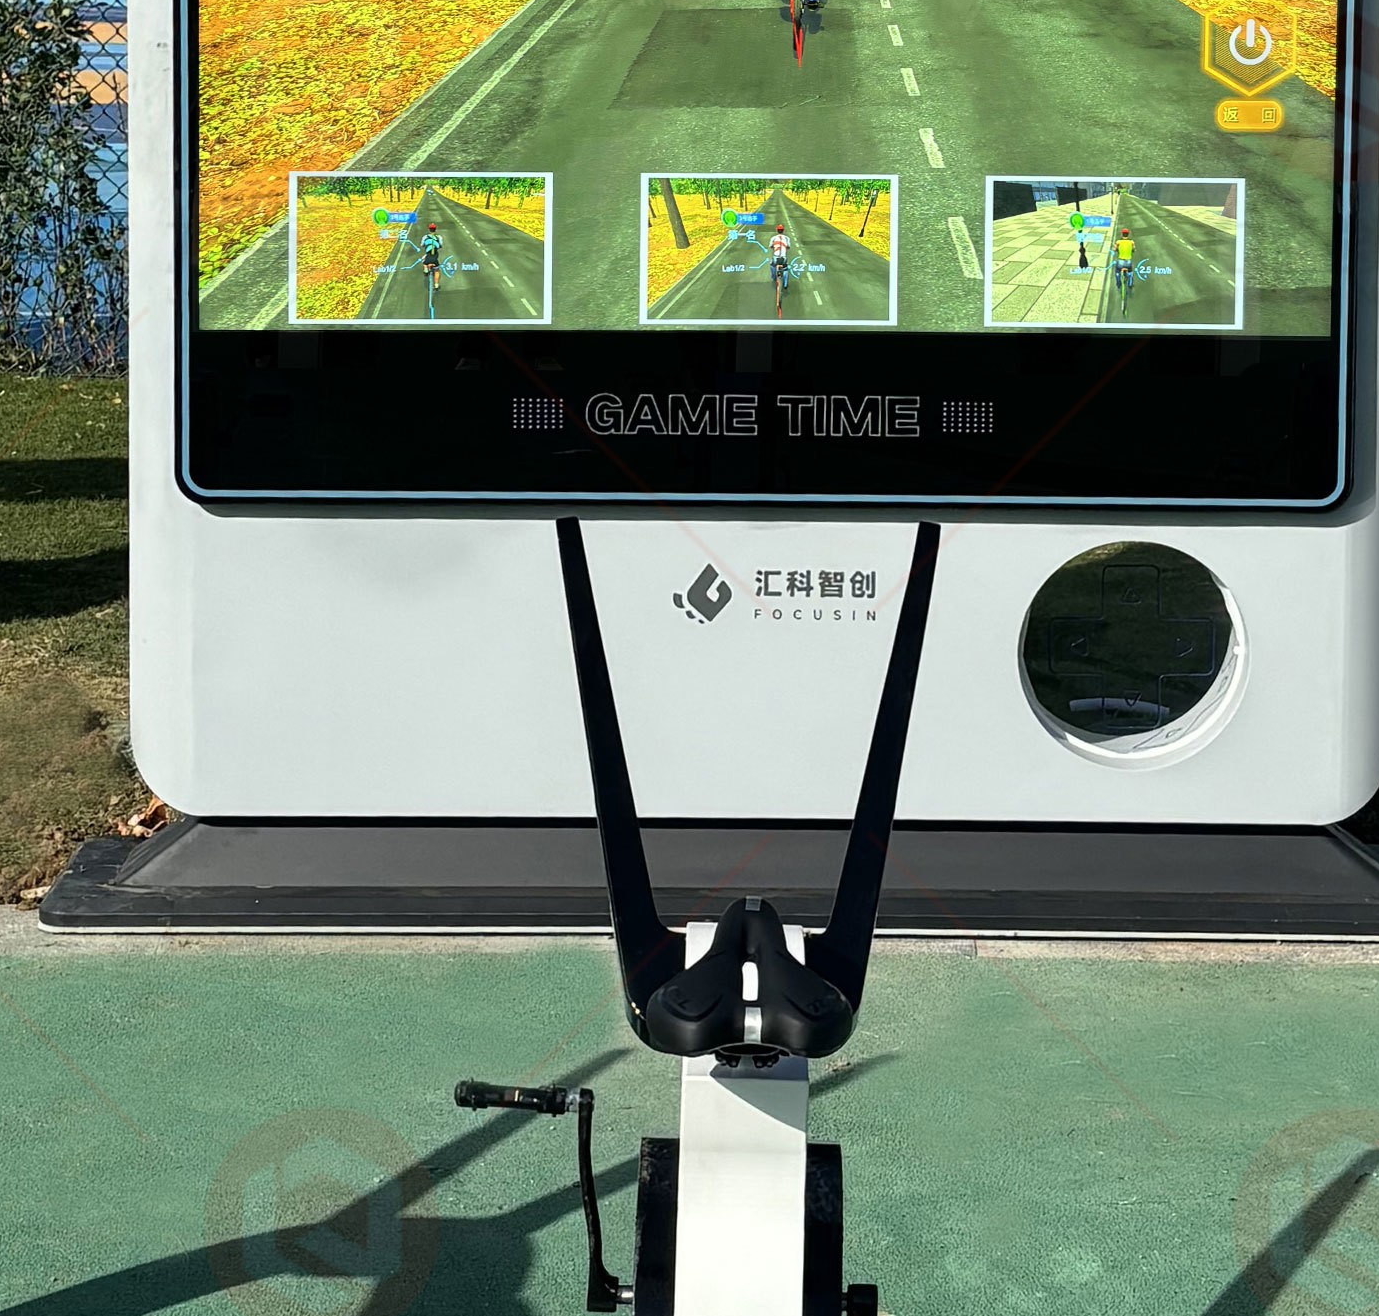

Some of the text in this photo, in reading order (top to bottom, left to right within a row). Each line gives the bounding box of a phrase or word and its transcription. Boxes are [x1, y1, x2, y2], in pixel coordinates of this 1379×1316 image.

[585, 393, 920, 437] GAME TIME
[754, 569, 877, 599] 汇科智创
[754, 609, 877, 621] FOCUSIN
